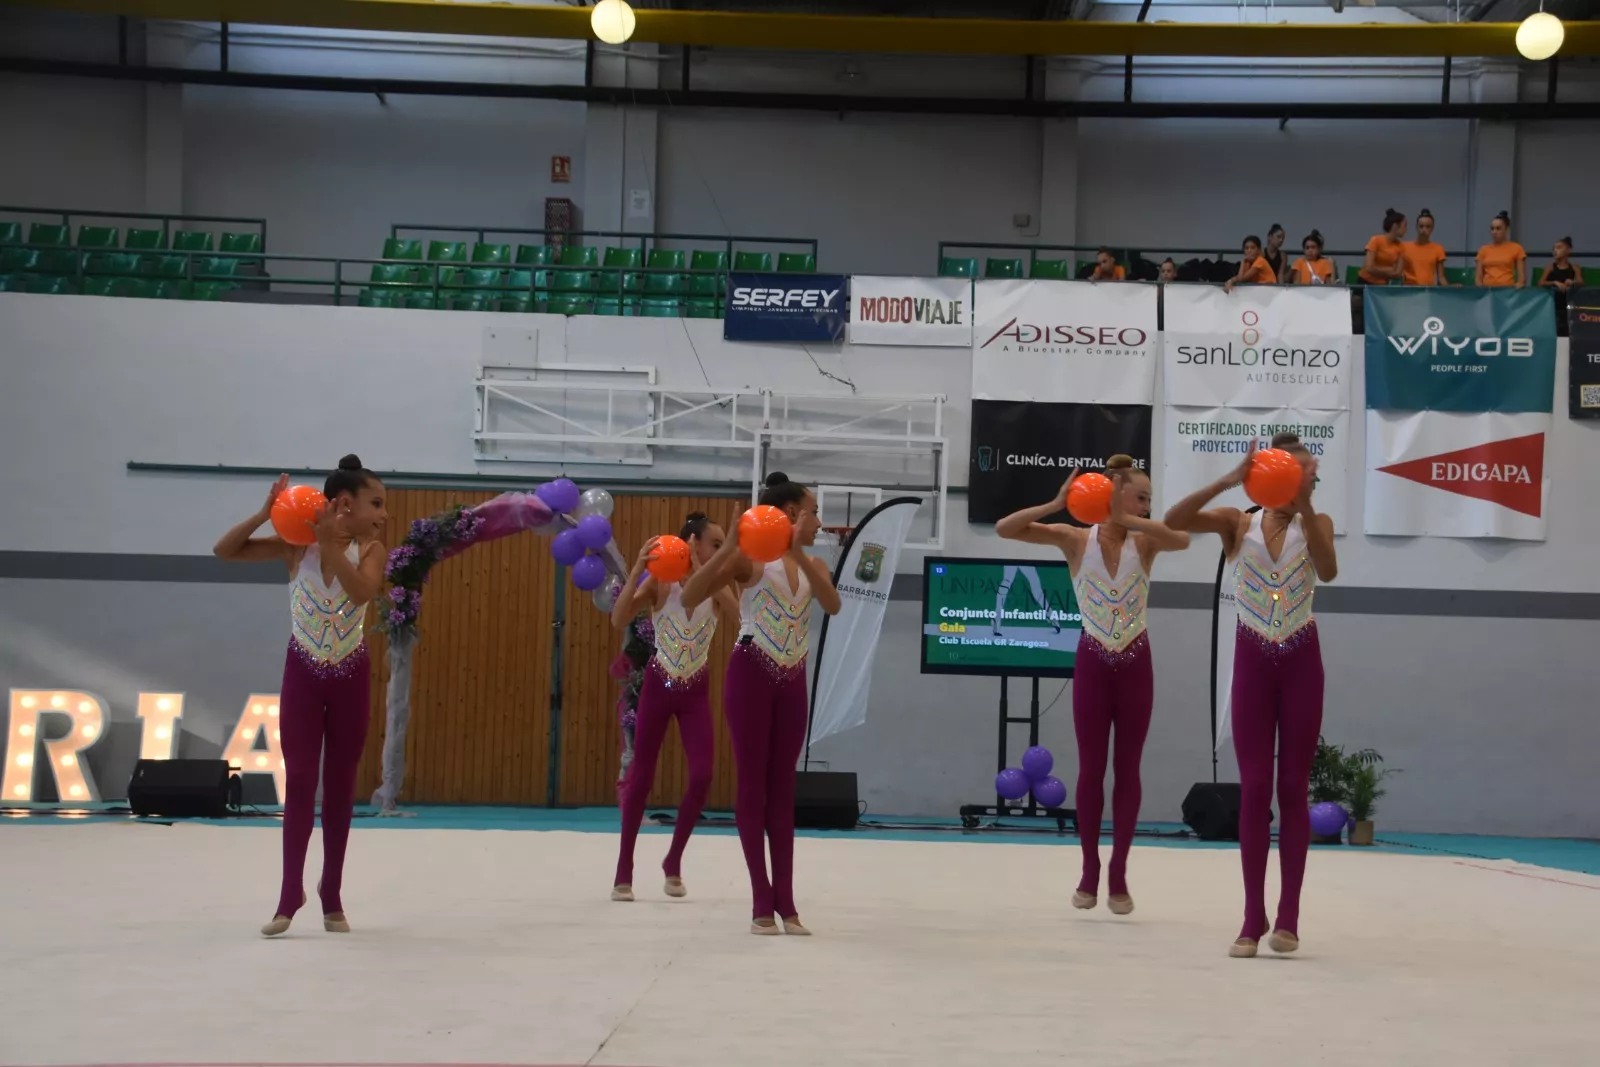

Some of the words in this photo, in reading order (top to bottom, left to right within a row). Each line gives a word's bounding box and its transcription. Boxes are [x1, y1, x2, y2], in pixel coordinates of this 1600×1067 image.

[732, 287, 839, 307] SERFEY
[860, 296, 962, 325] MODOVIAJE
[980, 317, 1147, 348] ADISSEO
[1018, 345, 1077, 354] Bluestar
[1086, 347, 1147, 357] Company
[1177, 342, 1340, 368] sanLorenzo
[1431, 364, 1462, 373] PEOPLE
[1465, 365, 1488, 373] FIRST
[1246, 373, 1339, 385] AUTOESCUELA
[1178, 422, 1257, 436] CERTIFICADOS
[1192, 439, 1253, 454] PROYECTO
[1006, 453, 1055, 467] CLINÍCA
[1058, 457, 1105, 468] DENTAL
[1431, 462, 1532, 484] EDIGAPA
[837, 584, 888, 600] BARBASTRO
[940, 607, 997, 621] Conjunto
[1000, 608, 1046, 621] Infantil
[939, 622, 966, 633] Gala
[939, 636, 959, 645] Club
[961, 637, 992, 646] Escuela
[994, 638, 1007, 646] GR
[1009, 639, 1049, 649] Zaragoza
